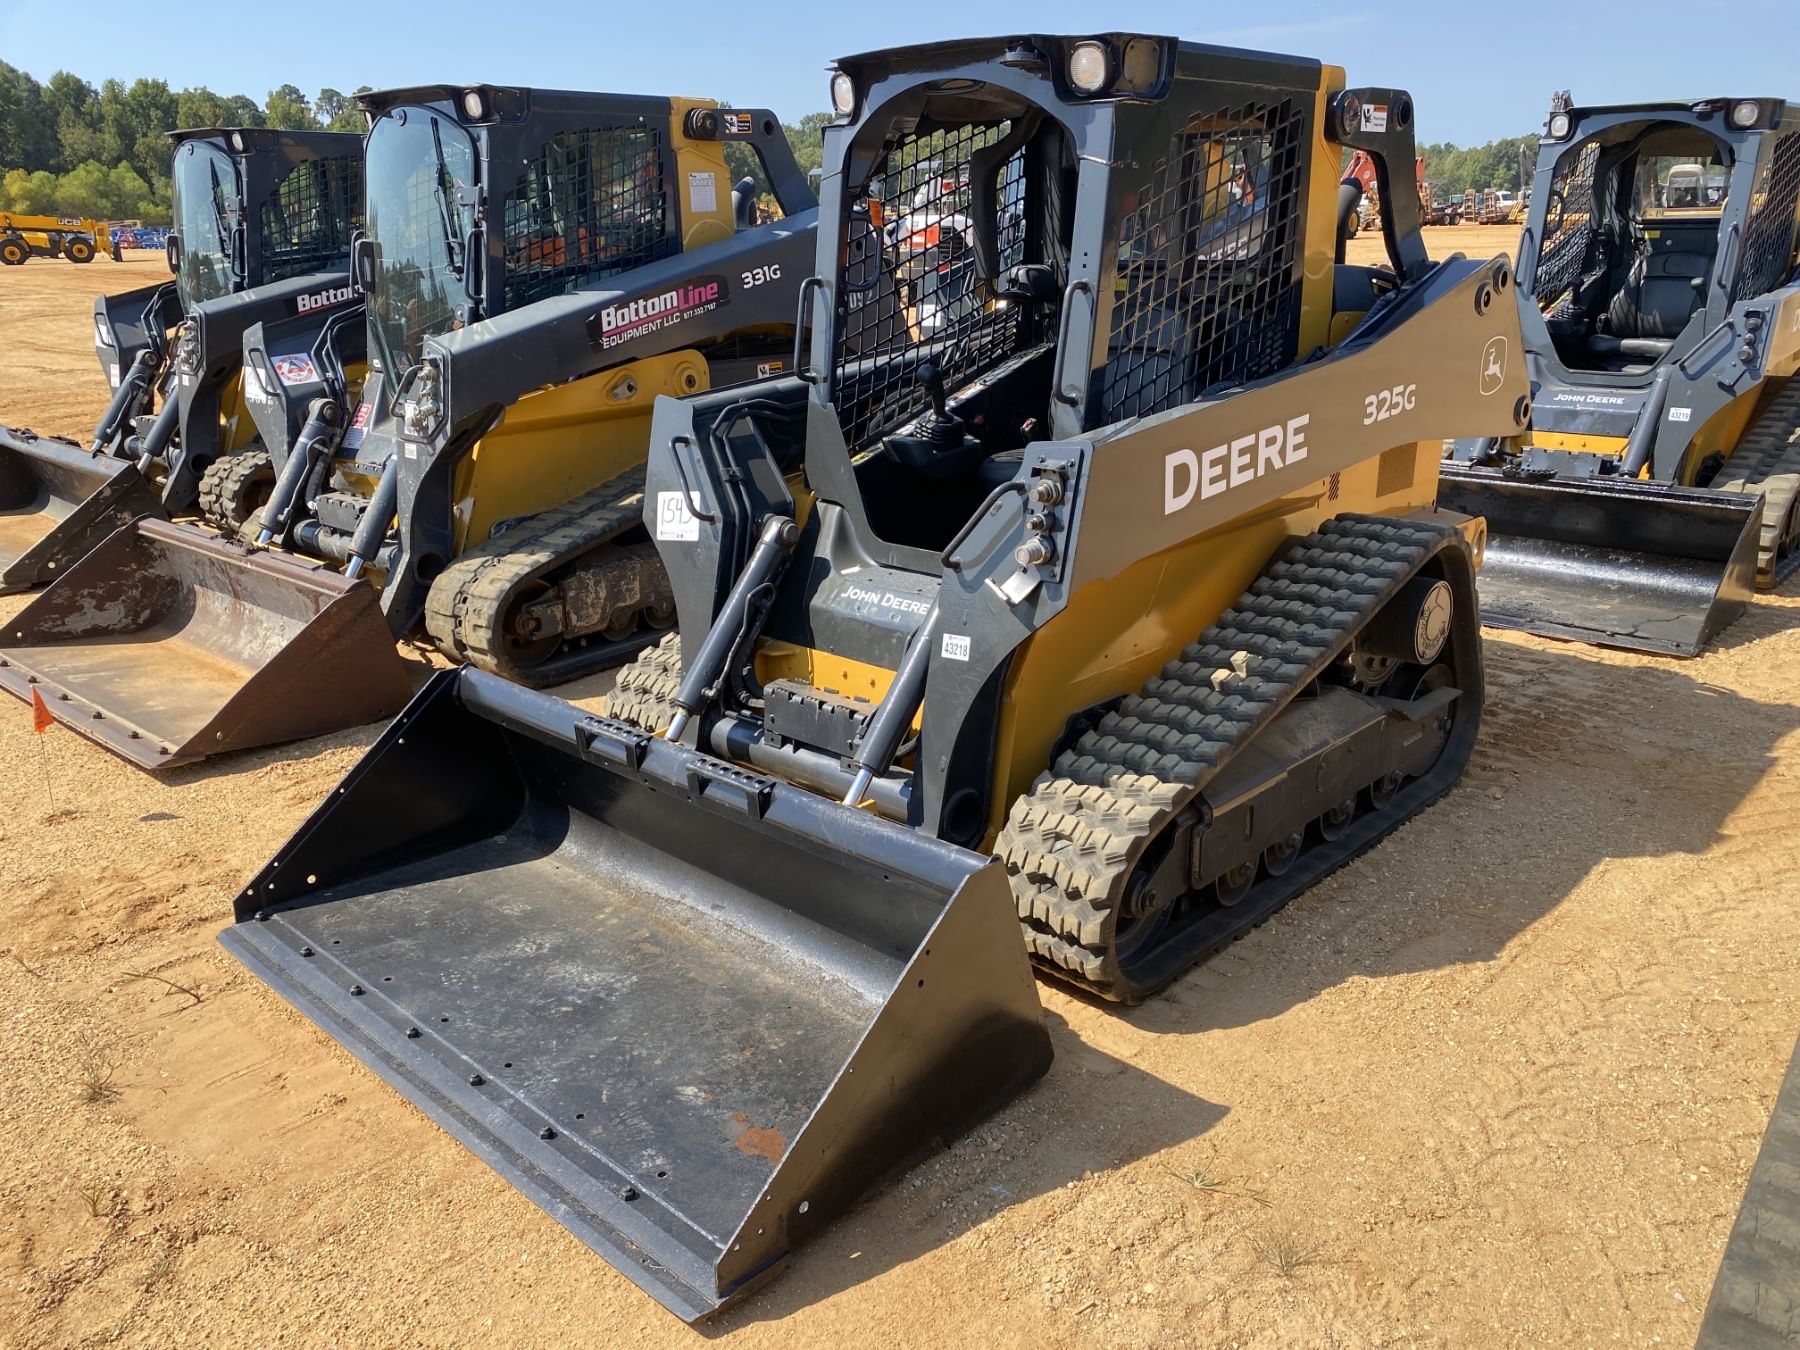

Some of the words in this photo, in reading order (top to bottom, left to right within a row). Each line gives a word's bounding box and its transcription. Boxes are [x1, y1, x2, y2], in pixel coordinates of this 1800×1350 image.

[57, 217, 81, 226] JCB
[741, 264, 782, 289] 331G
[602, 319, 662, 350] EQUIPMENT
[663, 312, 681, 328] LLC
[1363, 383, 1417, 426] 325G
[1553, 393, 1586, 402] JOHN
[1586, 394, 1625, 405] DEERE
[1164, 413, 1310, 516] DEERE
[841, 585, 881, 605] JOHN
[881, 592, 931, 615] DEERE
[944, 641, 968, 657] 43218
